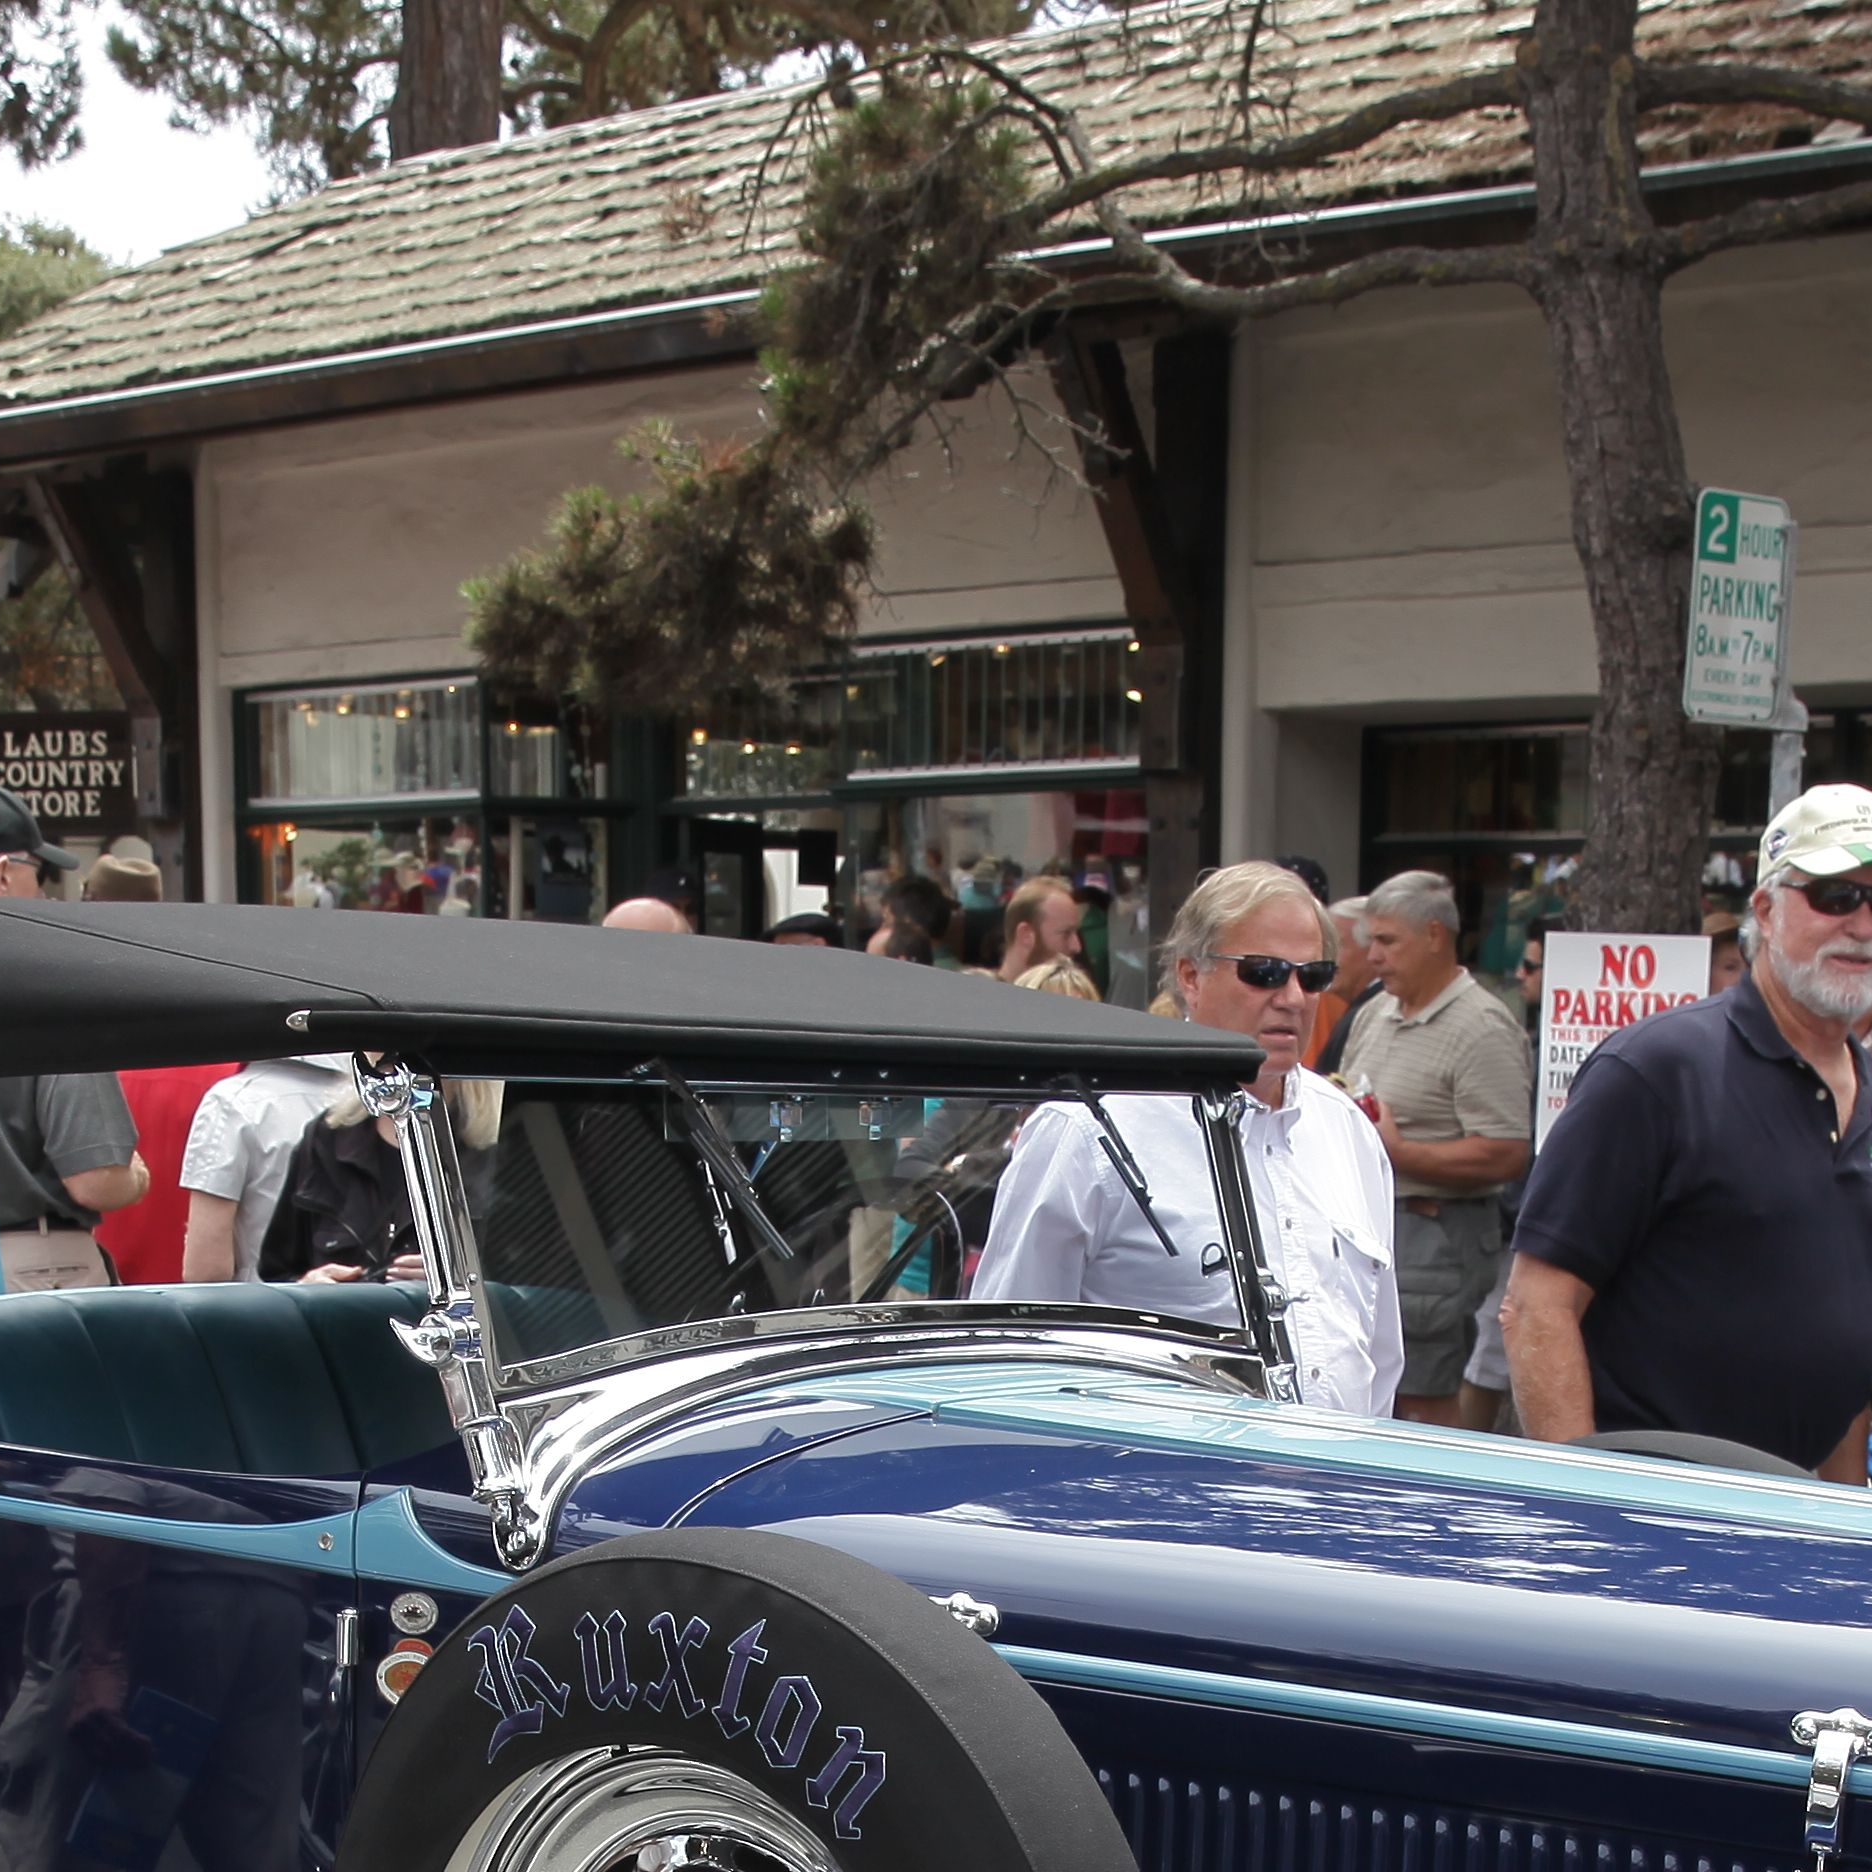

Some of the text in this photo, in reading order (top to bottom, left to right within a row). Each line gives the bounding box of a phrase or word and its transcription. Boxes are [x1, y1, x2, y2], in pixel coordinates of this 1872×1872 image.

[1707, 504, 1782, 559] 2 HOUR
[1698, 575, 1777, 622] PARKING
[17, 790, 101, 817] TORE
[1600, 944, 1656, 988] NO
[1551, 1028, 1581, 1042] THIS
[466, 1603, 886, 1840] Ruxton
